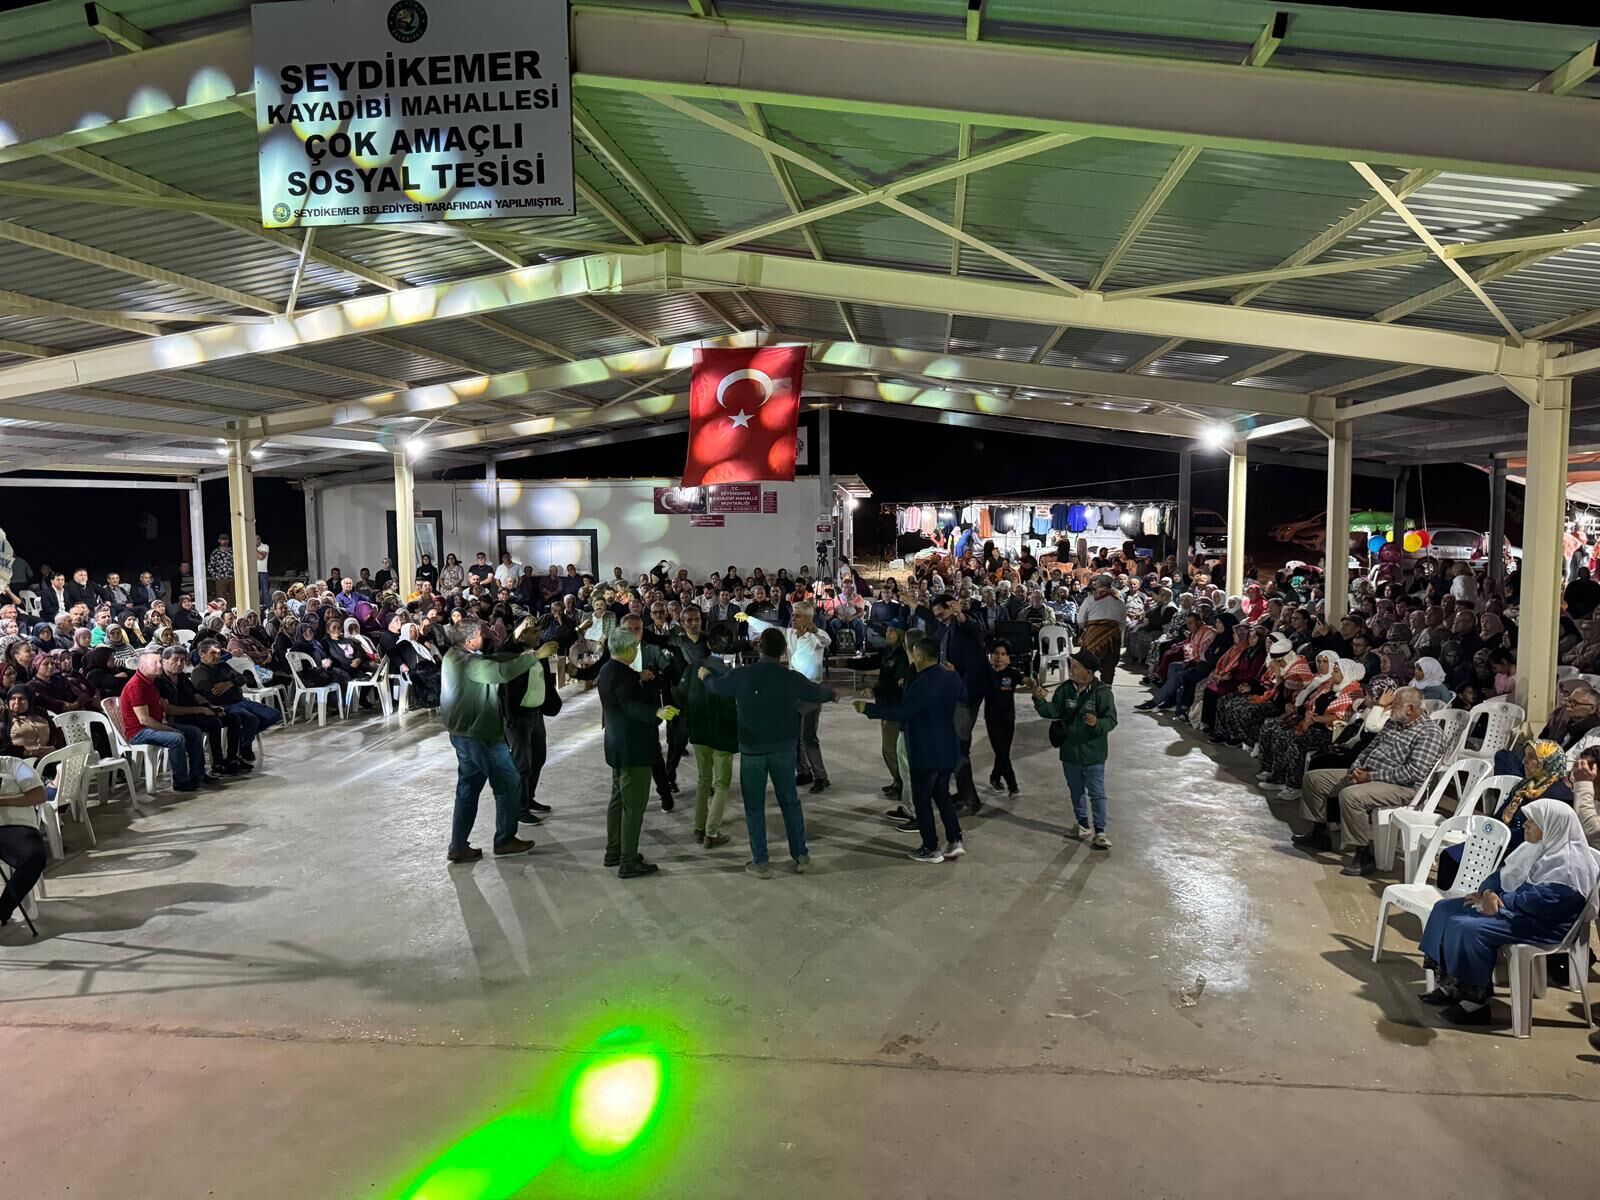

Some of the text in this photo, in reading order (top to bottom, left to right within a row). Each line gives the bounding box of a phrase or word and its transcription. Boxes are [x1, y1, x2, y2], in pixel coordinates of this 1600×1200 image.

[280, 50, 542, 94] SEYDİKEMER
[267, 83, 559, 124] KAYADİBİ MAHALLESİ
[305, 123, 523, 166] ÇOK AMAÇLI
[287, 152, 545, 196] SOSYAL TESİSİ
[293, 206, 360, 218] SEYDİKEMER
[362, 202, 423, 214] BELEDİYESİ
[426, 200, 492, 212] TARAFINDAN
[495, 197, 565, 209] YAPILMIŞTIR.
